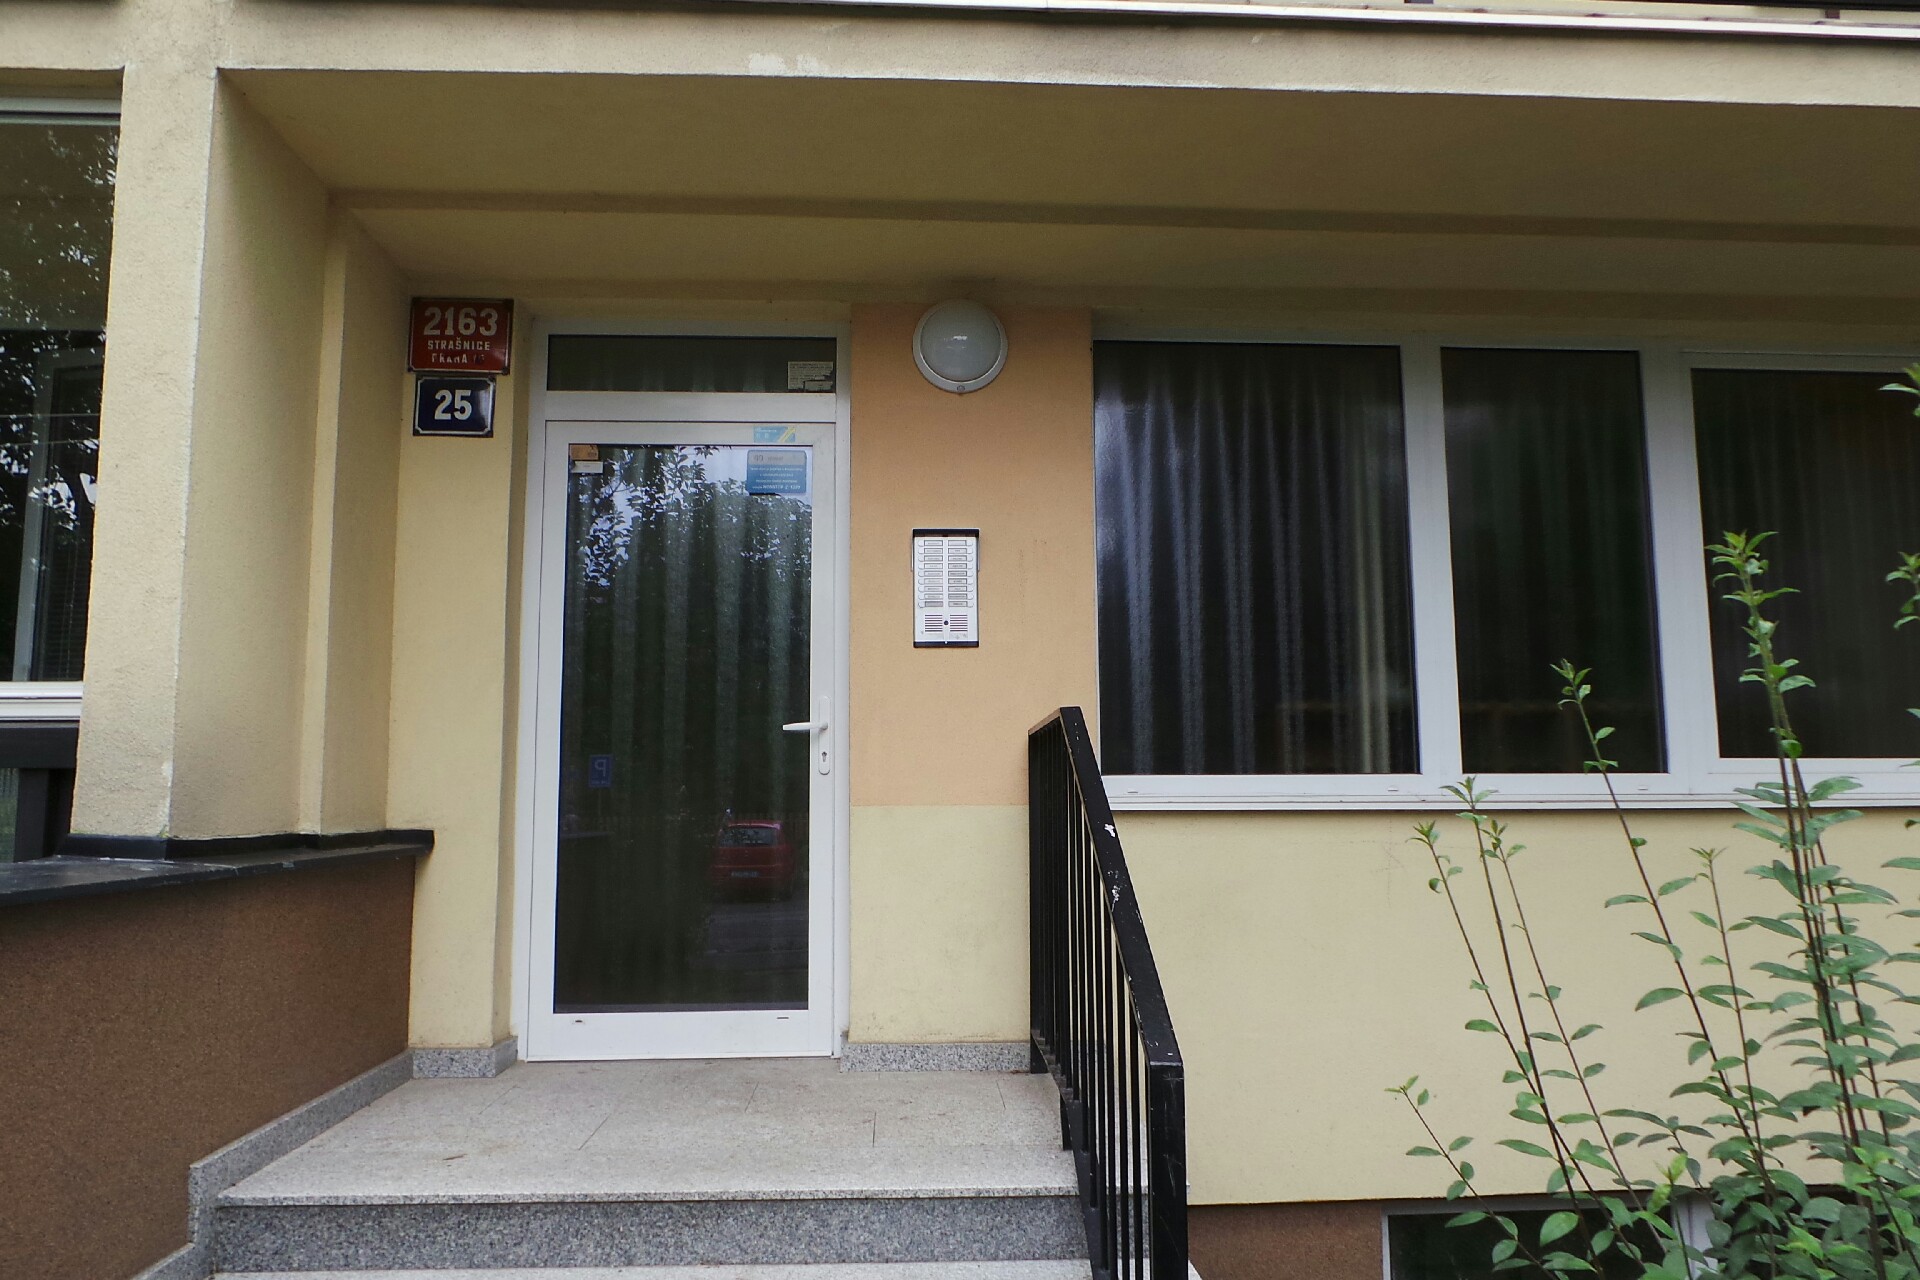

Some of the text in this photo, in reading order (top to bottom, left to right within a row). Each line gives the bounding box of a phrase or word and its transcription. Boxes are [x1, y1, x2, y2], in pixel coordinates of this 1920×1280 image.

[423, 307, 498, 336] 2163
[427, 337, 491, 351] STRAŠNICE
[434, 389, 473, 421] 25
